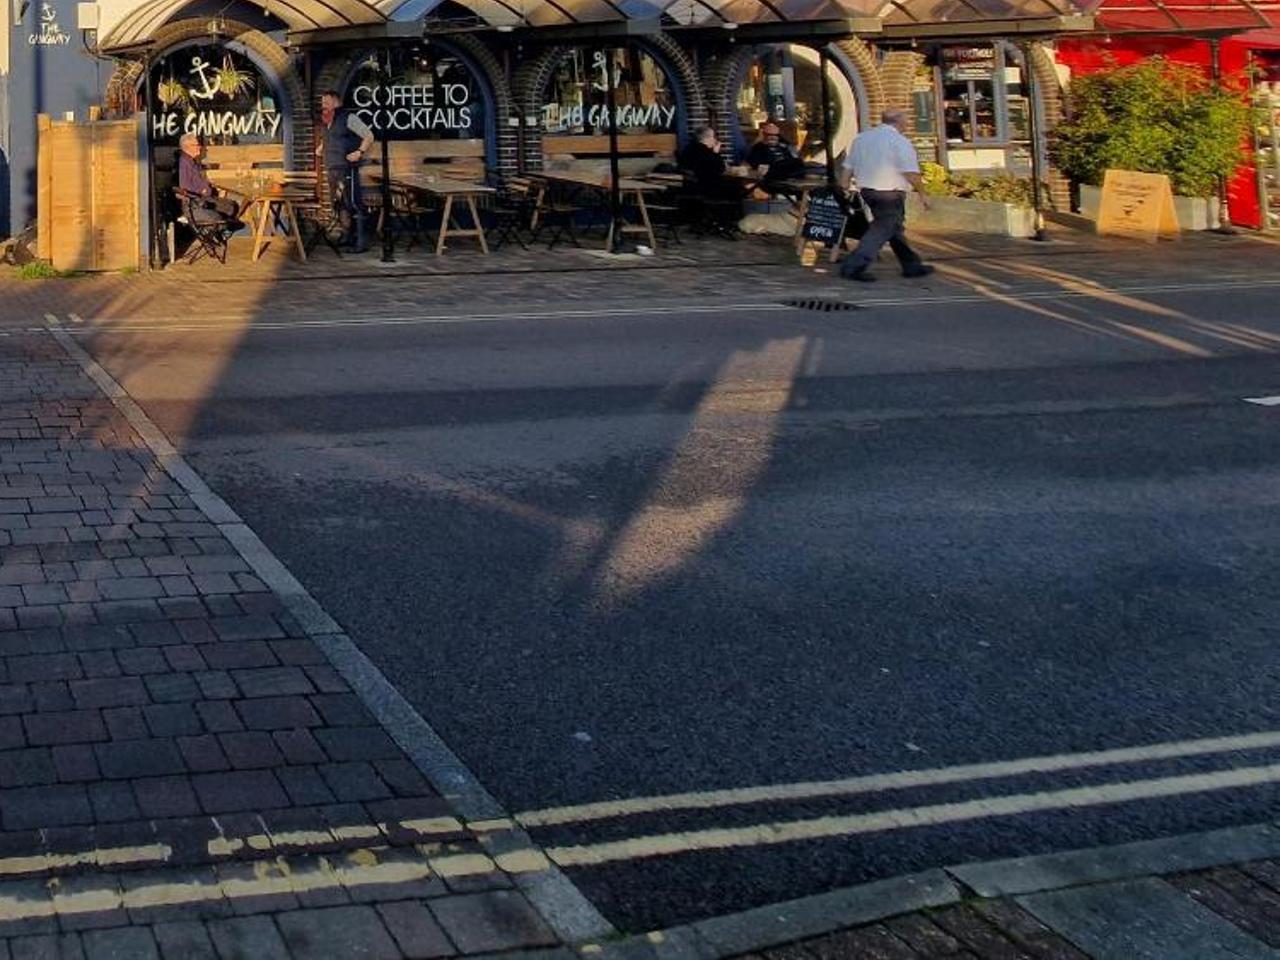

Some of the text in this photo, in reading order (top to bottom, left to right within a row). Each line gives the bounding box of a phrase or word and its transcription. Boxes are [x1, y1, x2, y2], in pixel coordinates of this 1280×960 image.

[353, 83, 469, 107] COFFEE TO
[152, 109, 281, 139] HE GANGWAY
[355, 107, 472, 130] COCKTAILS
